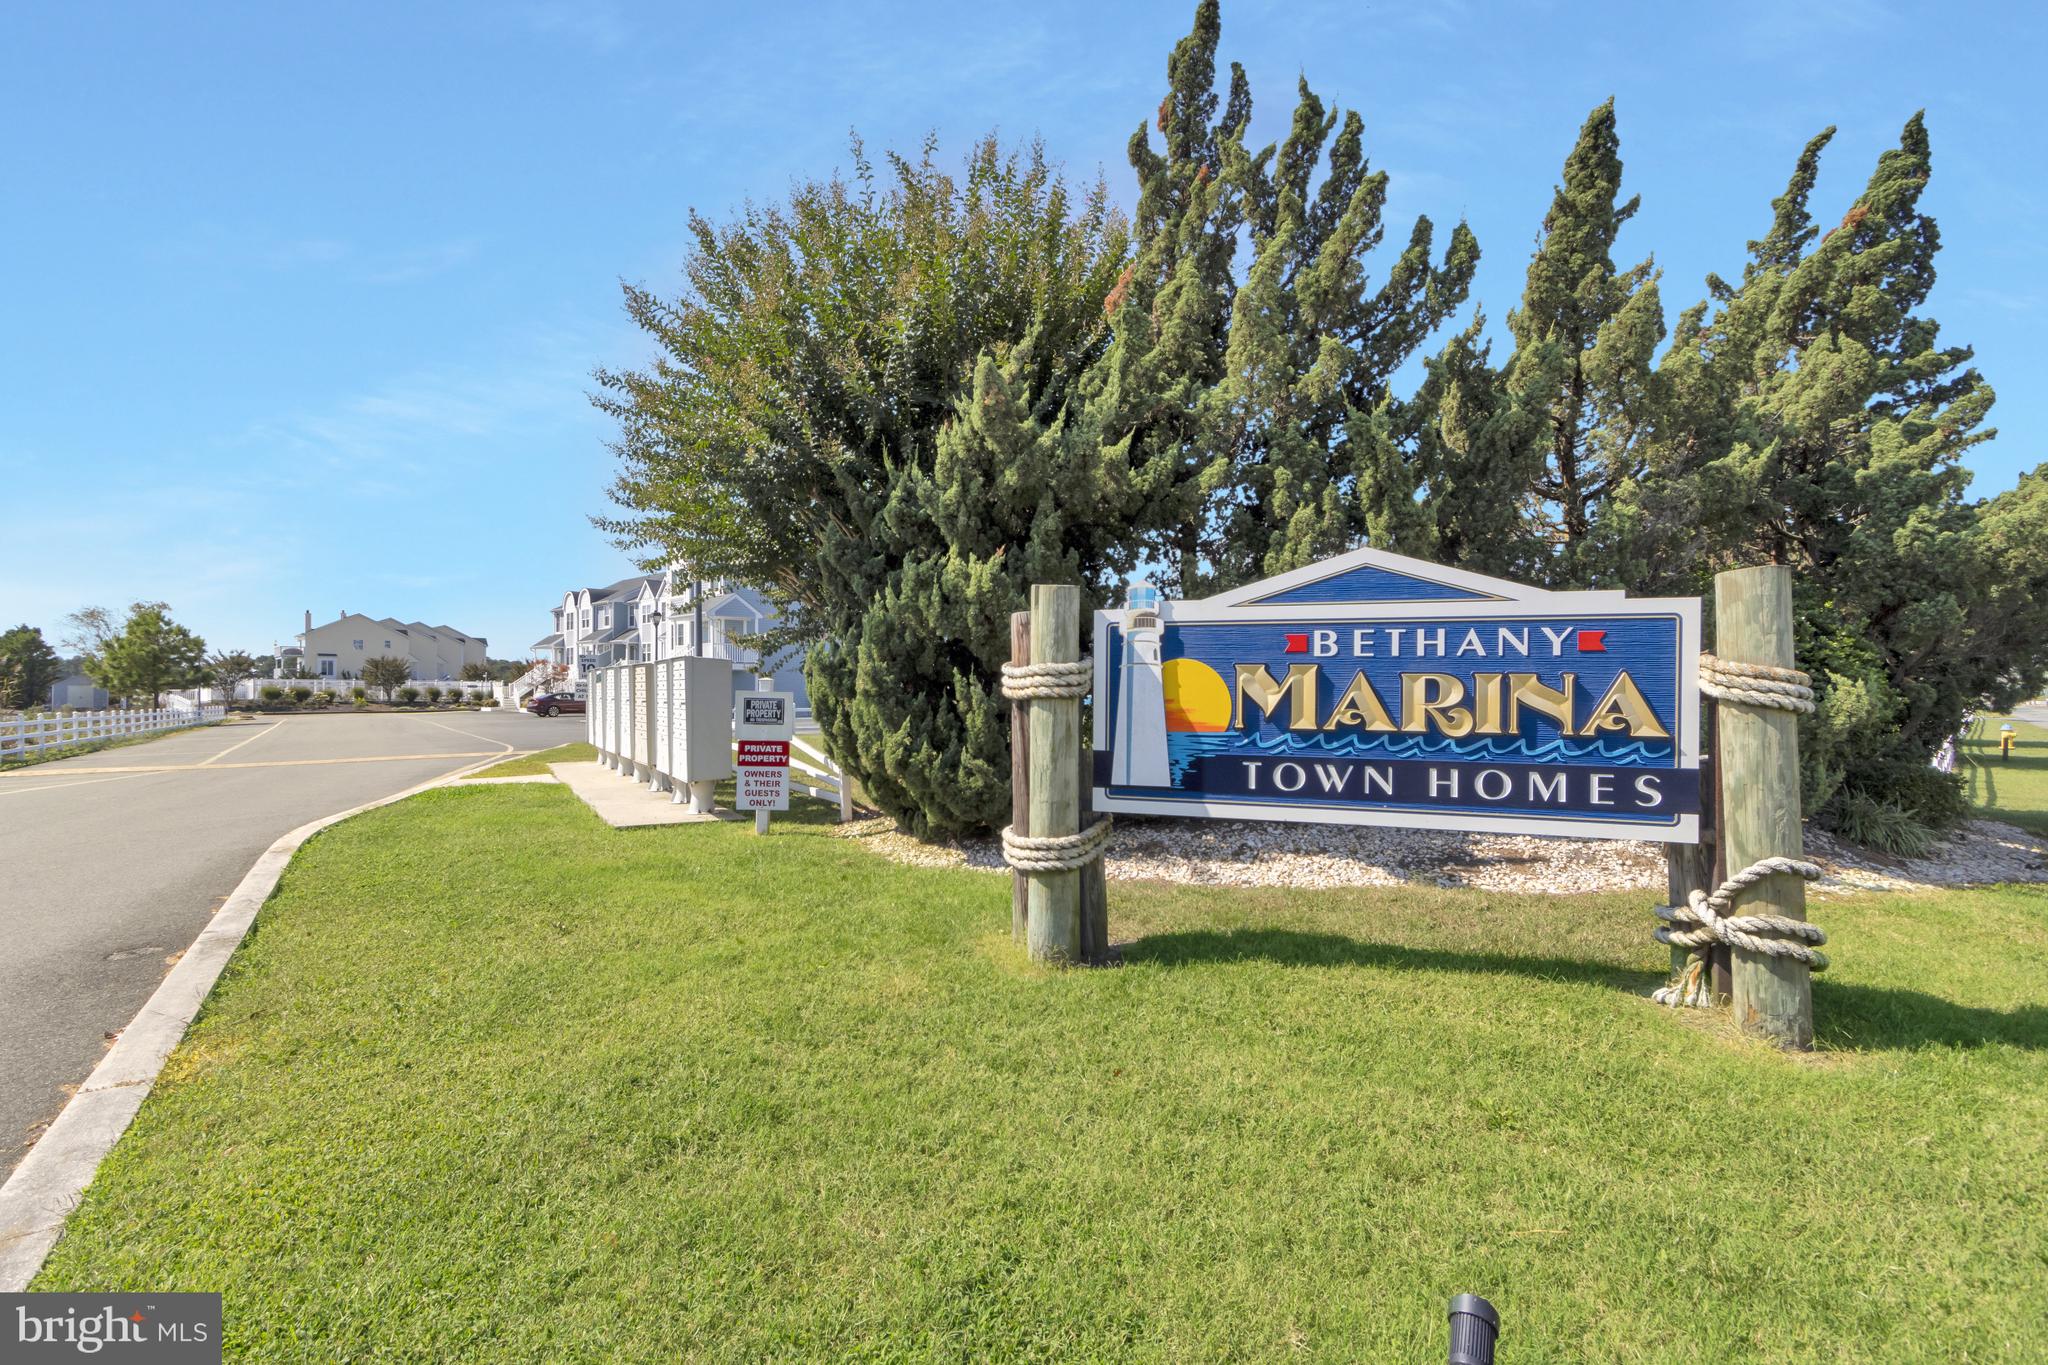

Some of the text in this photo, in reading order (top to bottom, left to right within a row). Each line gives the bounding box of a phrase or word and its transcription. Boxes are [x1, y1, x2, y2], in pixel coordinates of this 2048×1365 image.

[1313, 626, 1574, 657] BETHANY
[1233, 662, 1672, 738] MARINA
[751, 700, 778, 710] PRIVATE
[747, 709, 782, 719] PROPERTY
[744, 745, 783, 753] PRIVATE
[739, 754, 788, 763] PROPERTY
[744, 770, 783, 778] OWNERS
[744, 779, 781, 787] & THEIR
[1242, 761, 1663, 807] TOWN HOMES
[745, 789, 780, 797] GUESTS
[749, 799, 775, 807] ONLY!
